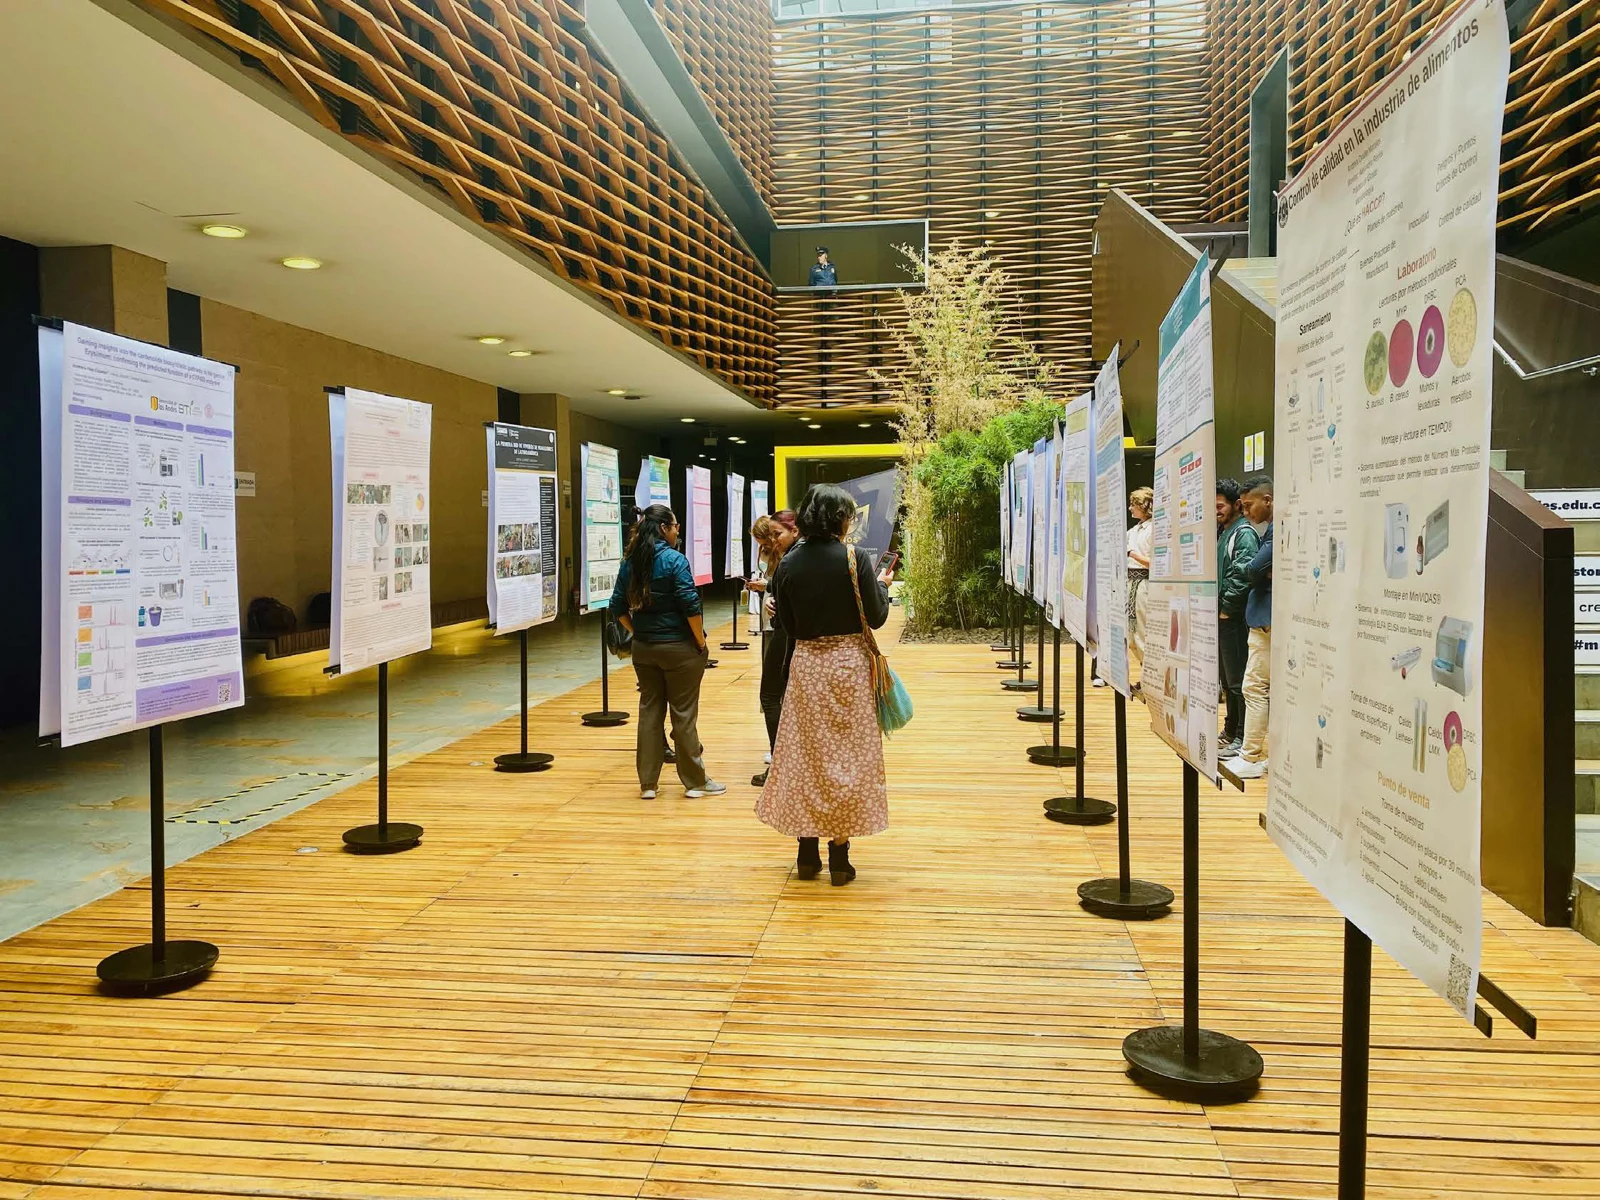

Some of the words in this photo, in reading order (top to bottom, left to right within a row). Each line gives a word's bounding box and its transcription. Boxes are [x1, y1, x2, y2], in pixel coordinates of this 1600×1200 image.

[1288, 176, 1311, 210] Control
[1311, 172, 1319, 189] de
[1319, 143, 1345, 180] calidad
[1345, 137, 1355, 157] en
[1354, 127, 1364, 147] la
[1363, 88, 1405, 136] industria
[1407, 74, 1420, 97] de
[1422, 18, 1479, 83] alimentos
[1458, 151, 1478, 174] Control
[1438, 208, 1455, 228] Control
[1462, 190, 1482, 211] calidad
[1397, 247, 1436, 280] Laboratorio
[1455, 274, 1467, 287] PCA
[1397, 288, 1407, 302] por
[1299, 312, 1331, 336] Saneamiento
[1539, 500, 1600, 511] es.edu.c
[1428, 726, 1442, 740] Caldo
[1378, 771, 1397, 793] Punto
[1397, 782, 1407, 798] de
[1408, 789, 1430, 809] venta
[1381, 797, 1394, 813] Toma
[1401, 811, 1424, 831] muestras
[1438, 856, 1448, 866] por
